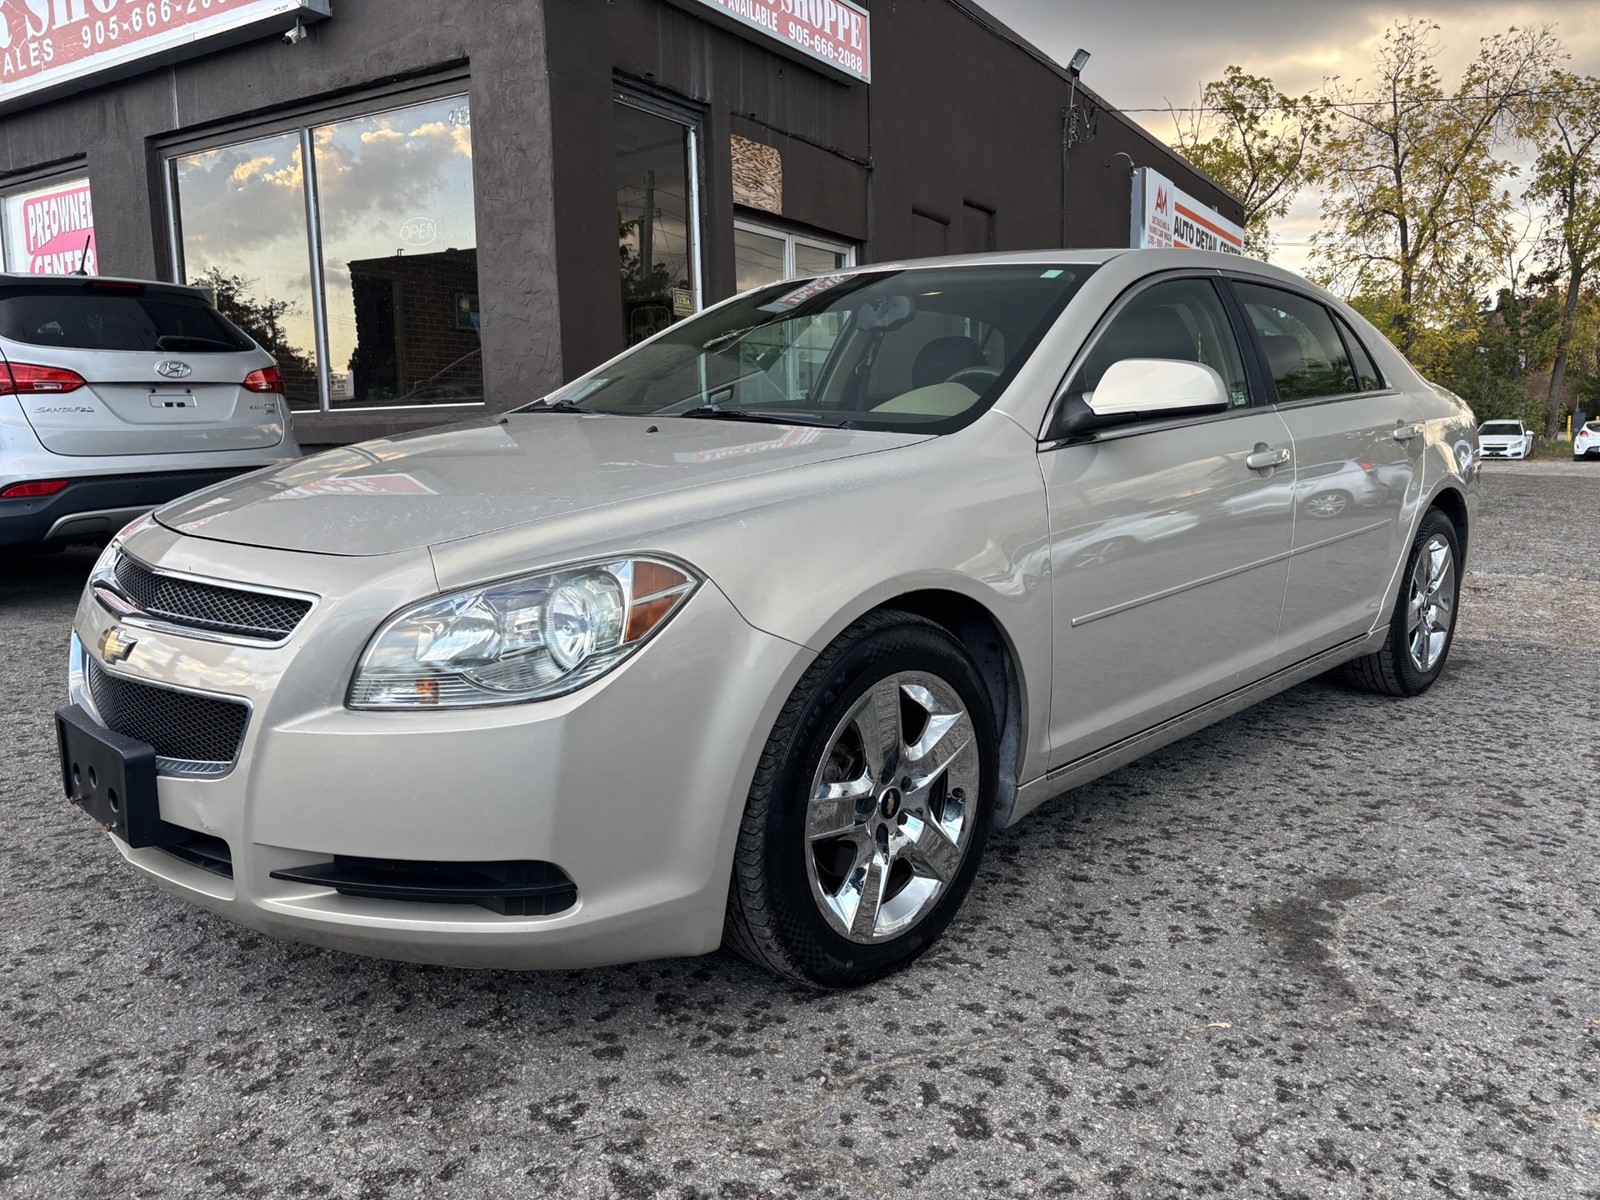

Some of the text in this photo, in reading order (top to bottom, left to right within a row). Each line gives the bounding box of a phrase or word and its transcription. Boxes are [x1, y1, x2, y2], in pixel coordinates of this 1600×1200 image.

[81, 0, 226, 49] 905-666-2
[788, 21, 863, 73] 905-666-2088
[400, 222, 437, 242] OPEN
[1174, 215, 1195, 245] AUTO
